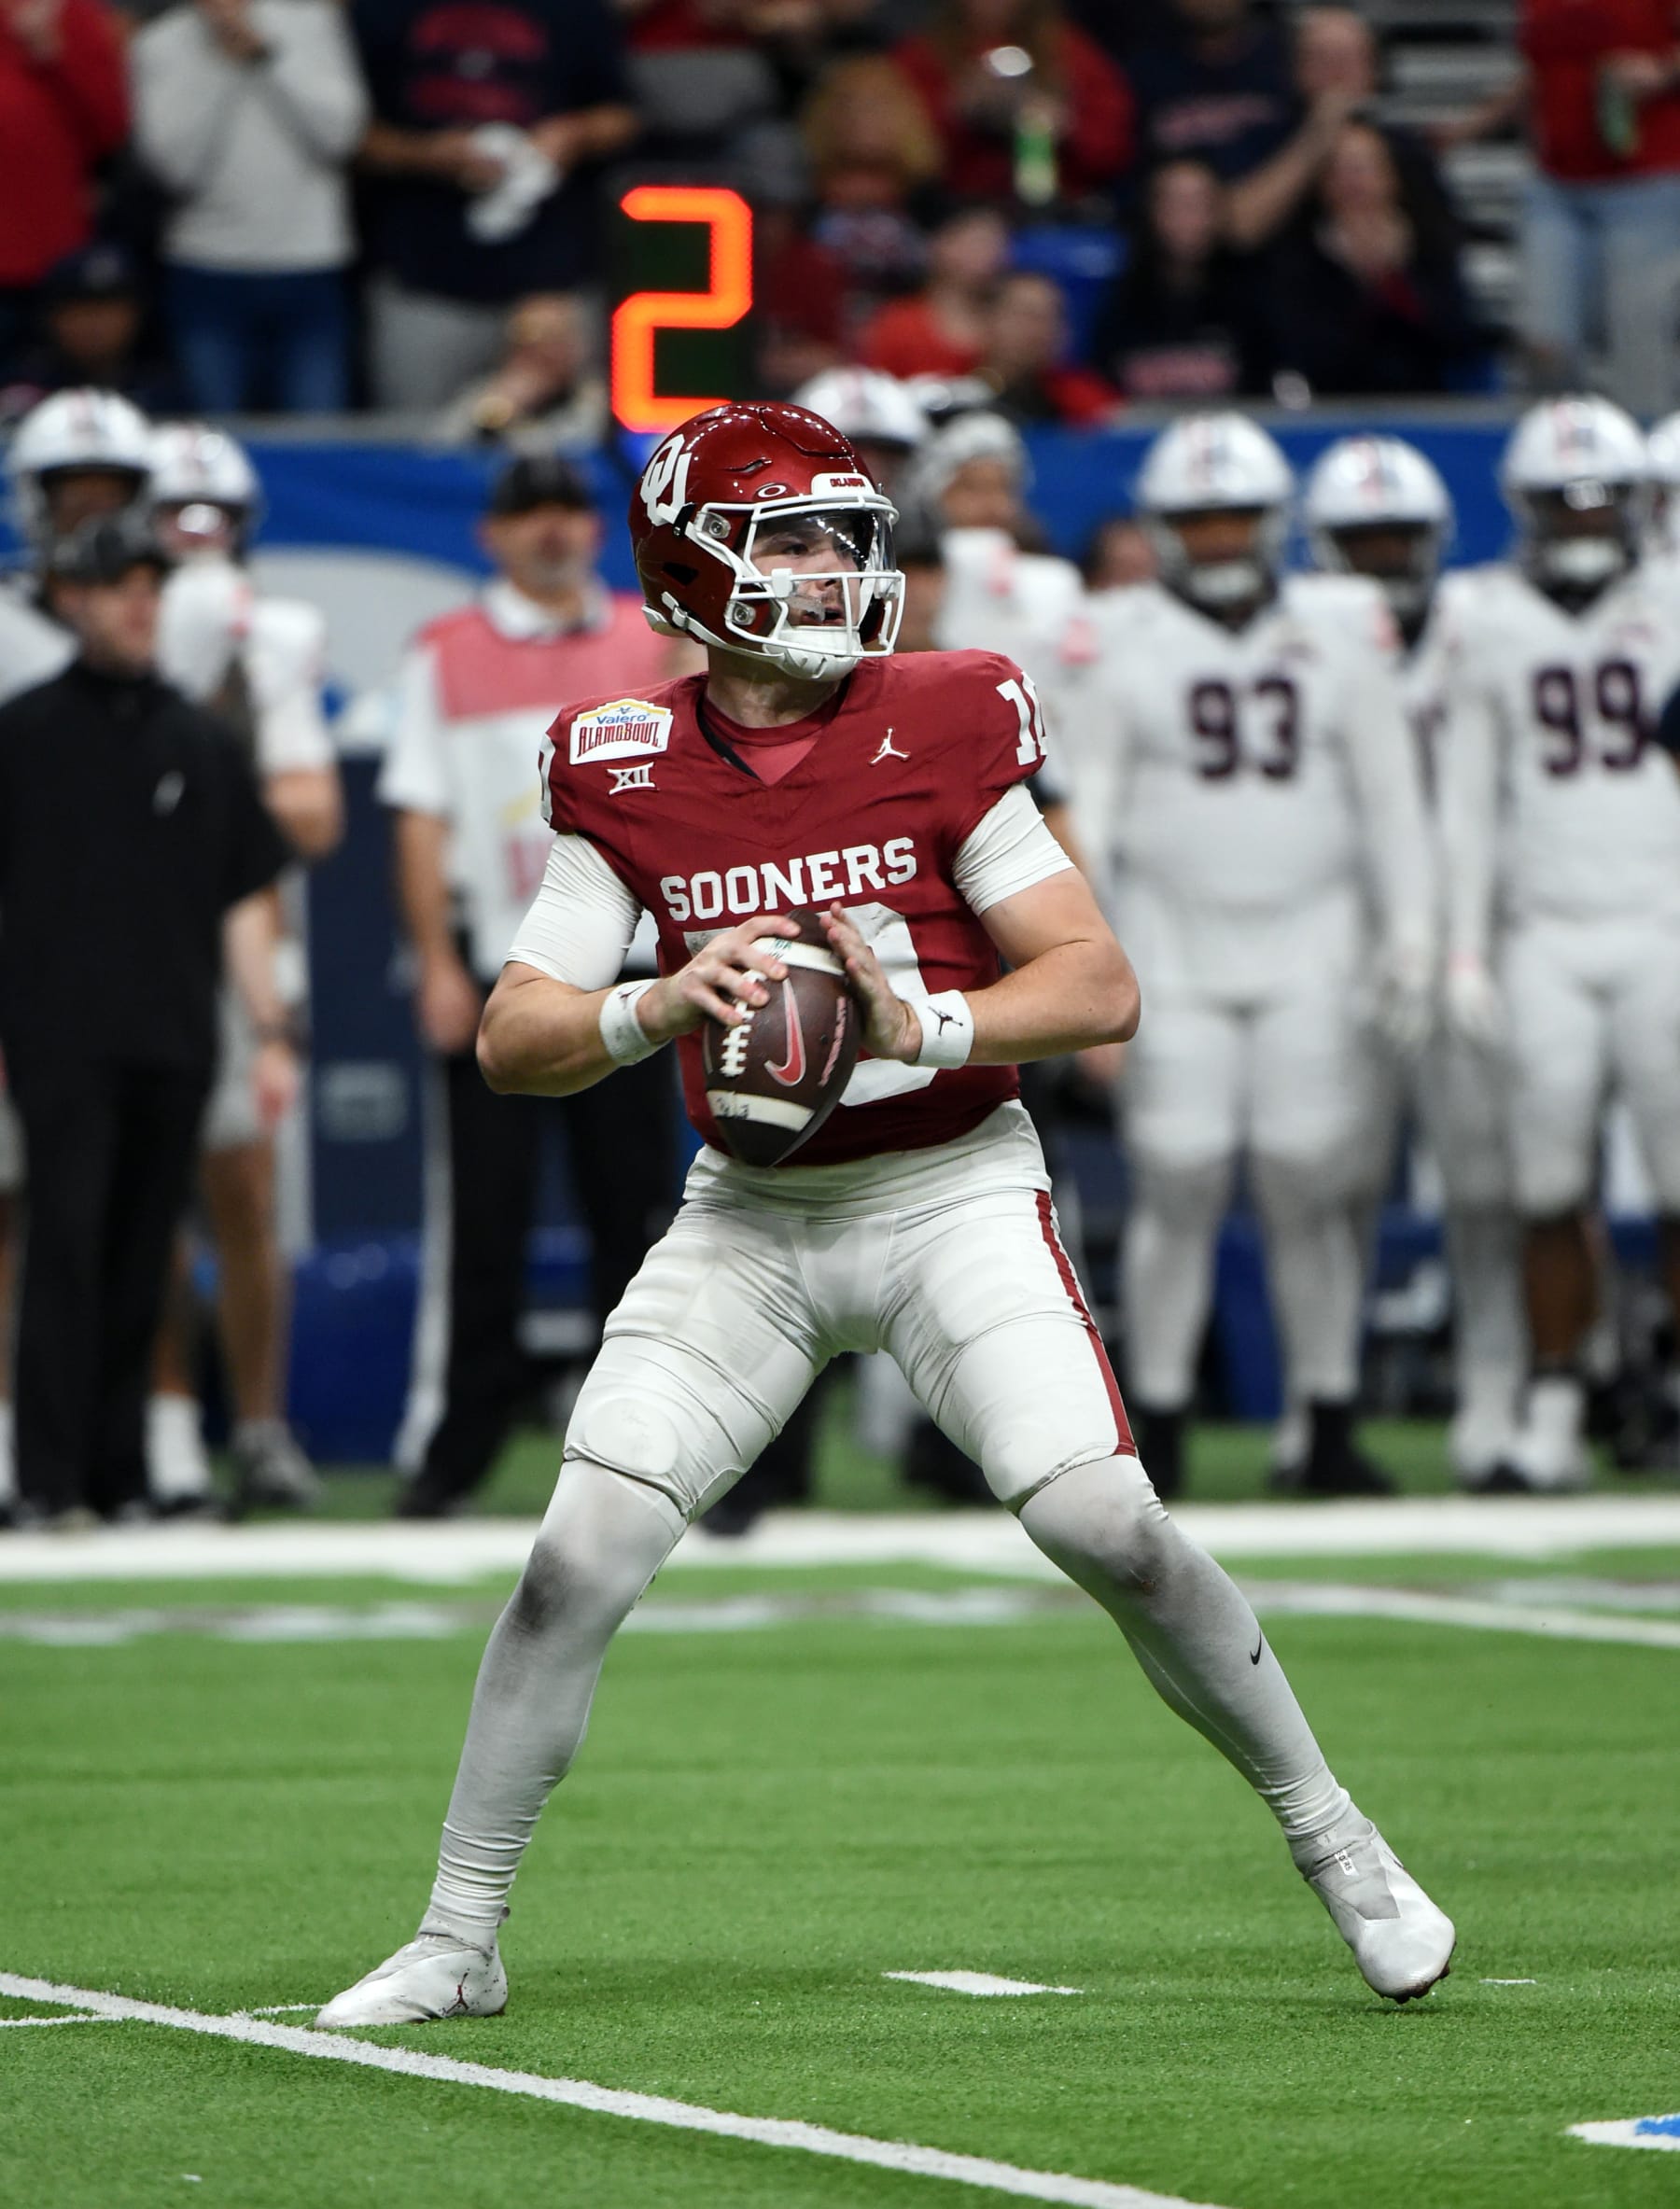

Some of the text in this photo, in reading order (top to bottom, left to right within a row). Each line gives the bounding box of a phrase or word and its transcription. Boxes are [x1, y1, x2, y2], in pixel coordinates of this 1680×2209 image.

[612, 186, 753, 434] 2
[596, 714, 647, 725] Valero
[1189, 678, 1301, 781] 93
[1532, 656, 1644, 777] 99
[606, 762, 656, 795] XII
[660, 836, 917, 922] SOONERS
